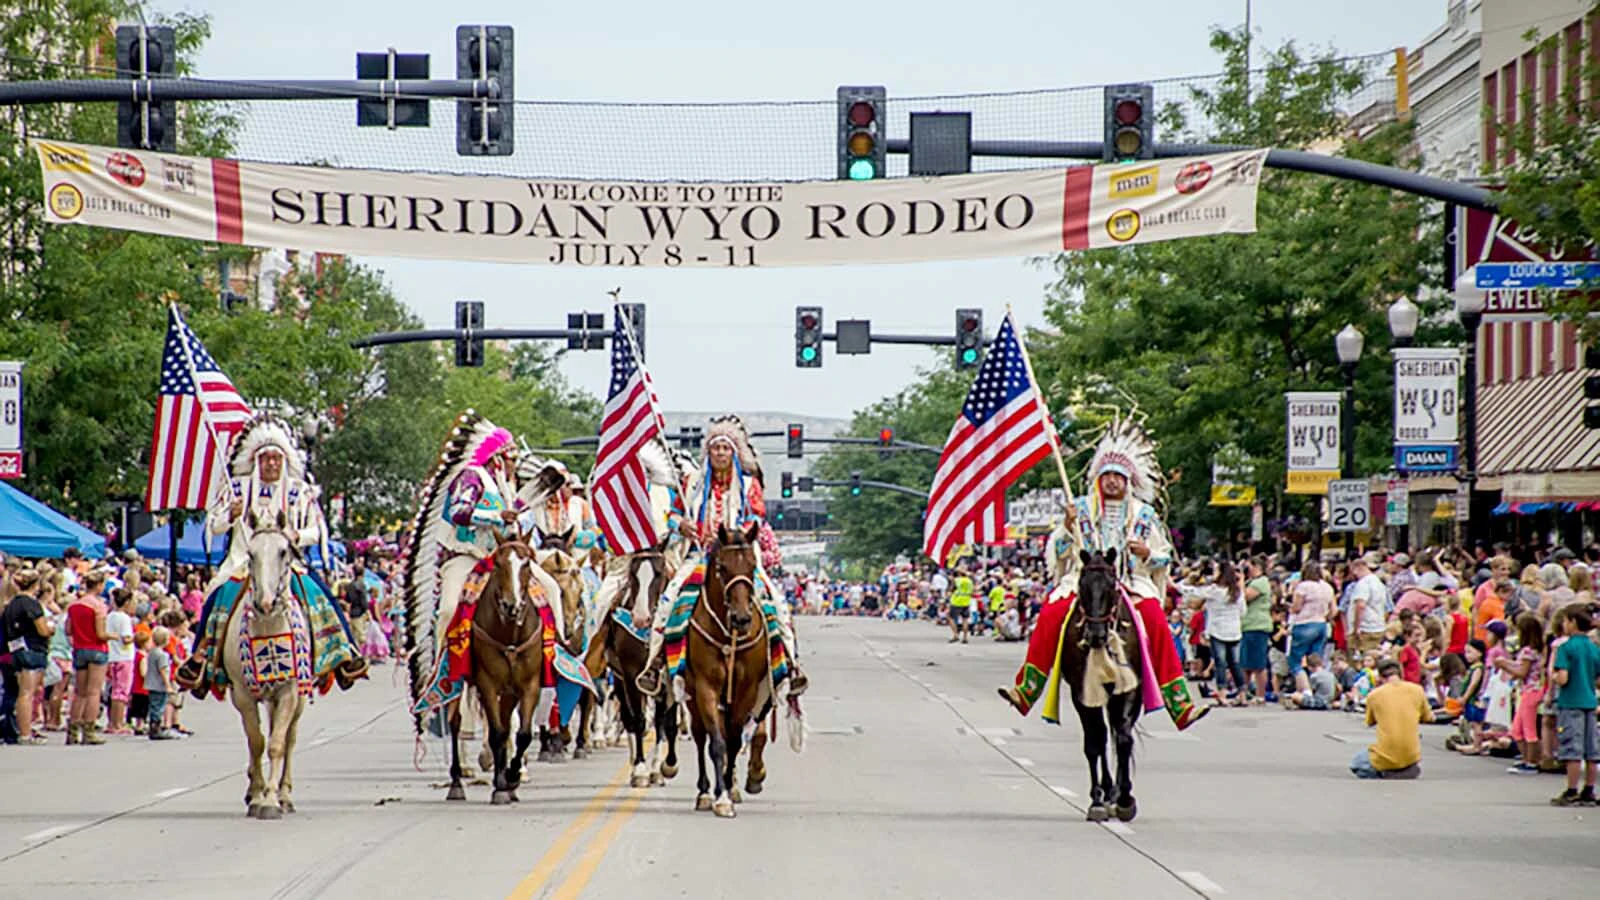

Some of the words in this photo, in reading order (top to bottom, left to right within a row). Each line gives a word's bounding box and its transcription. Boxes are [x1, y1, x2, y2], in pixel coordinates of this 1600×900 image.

[528, 183, 669, 201] WELCOME
[677, 187, 715, 202] TO
[725, 186, 783, 202] THE
[271, 188, 613, 239] SHERIDAN
[636, 205, 781, 241] WYO
[805, 193, 1034, 240] RODEO
[549, 243, 649, 266] JULY
[664, 244, 682, 266] 8
[727, 245, 760, 266] 11
[1509, 264, 1557, 277] LOUCKS
[1487, 288, 1560, 310] EWELRY
[1400, 361, 1457, 376] SHERIDAN
[1291, 404, 1337, 416] SHERIDAN
[1400, 388, 1455, 428] WYO
[1292, 425, 1337, 458] WYO
[1406, 451, 1447, 465] DASANI
[1333, 483, 1368, 493] SPEED
[1335, 495, 1363, 504] LIMIT
[1334, 508, 1366, 526] 20
